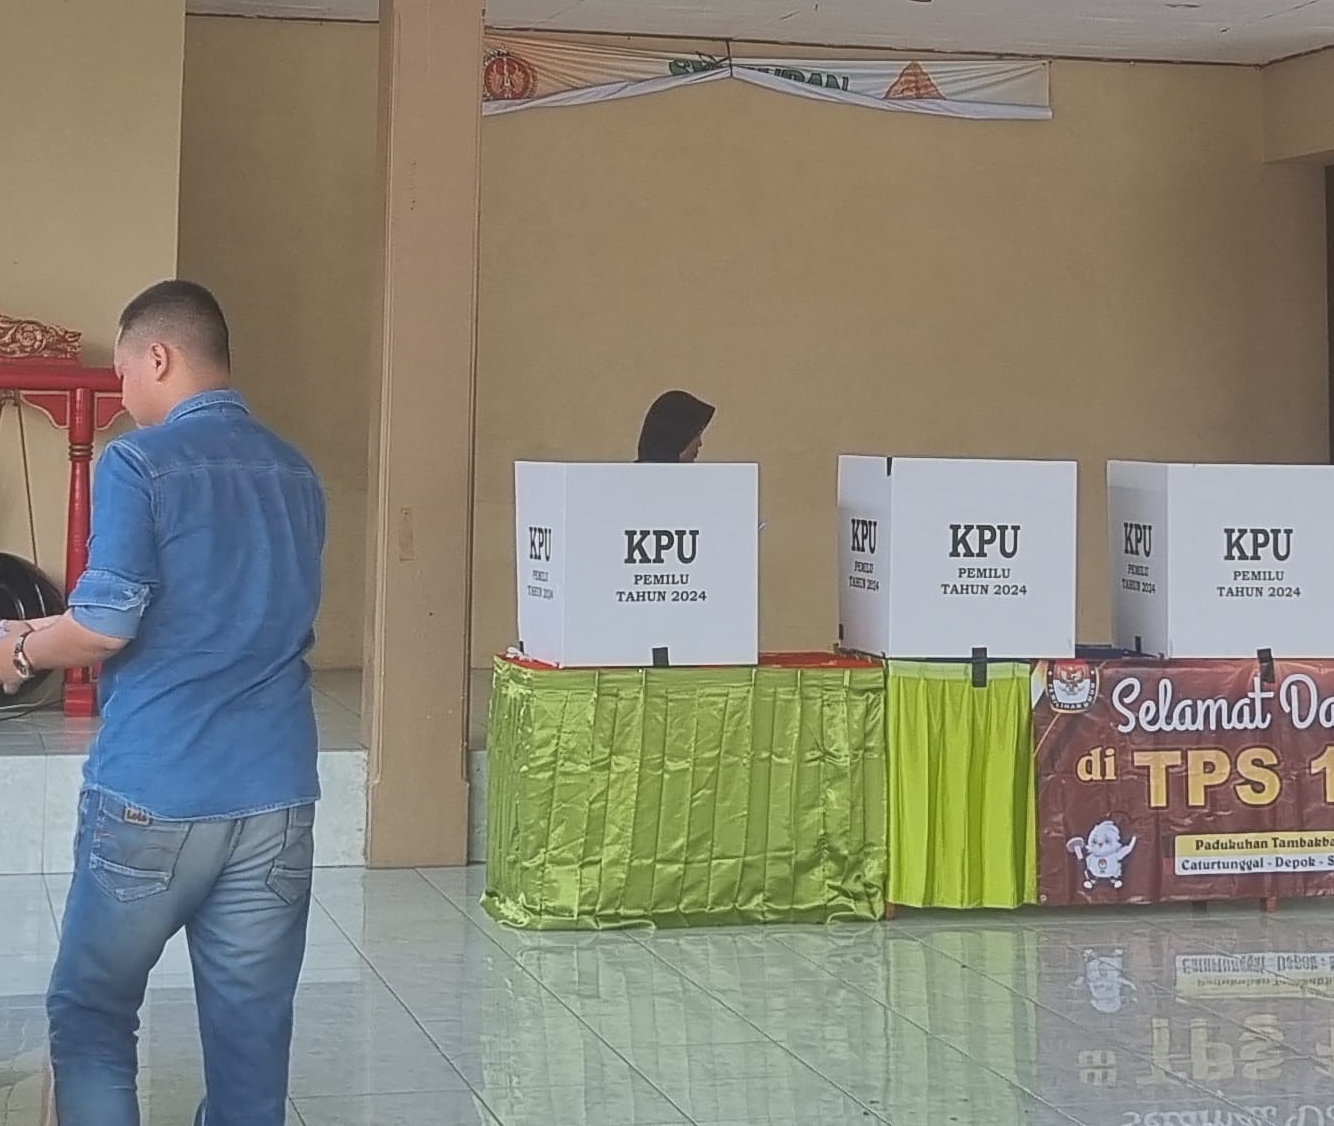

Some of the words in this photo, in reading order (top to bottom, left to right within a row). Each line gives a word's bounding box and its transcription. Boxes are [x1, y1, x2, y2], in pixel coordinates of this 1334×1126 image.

[529, 526, 551, 562] KPU
[624, 529, 699, 564] KPU
[851, 519, 877, 554] KPU
[949, 524, 1021, 558] KPU
[1123, 522, 1152, 557] KPU
[1224, 528, 1293, 561] KPU
[634, 574, 689, 585] PEMILU
[958, 568, 1011, 579] PEMILU
[1233, 570, 1284, 581] PEMILU
[616, 591, 666, 602] TAHUN
[671, 591, 707, 602] 2024
[941, 584, 989, 595] TAHUN
[993, 584, 1027, 596] 2024
[1216, 587, 1263, 597] TAHUN
[1268, 587, 1301, 597] 2024
[1112, 677, 1274, 733] Selamat
[1076, 747, 1117, 781] di
[1133, 746, 1282, 807] TPS
[1195, 839, 1268, 851] Padukuhan
[1181, 857, 1264, 871] Caturtunggal
[1275, 856, 1316, 868] Depok
